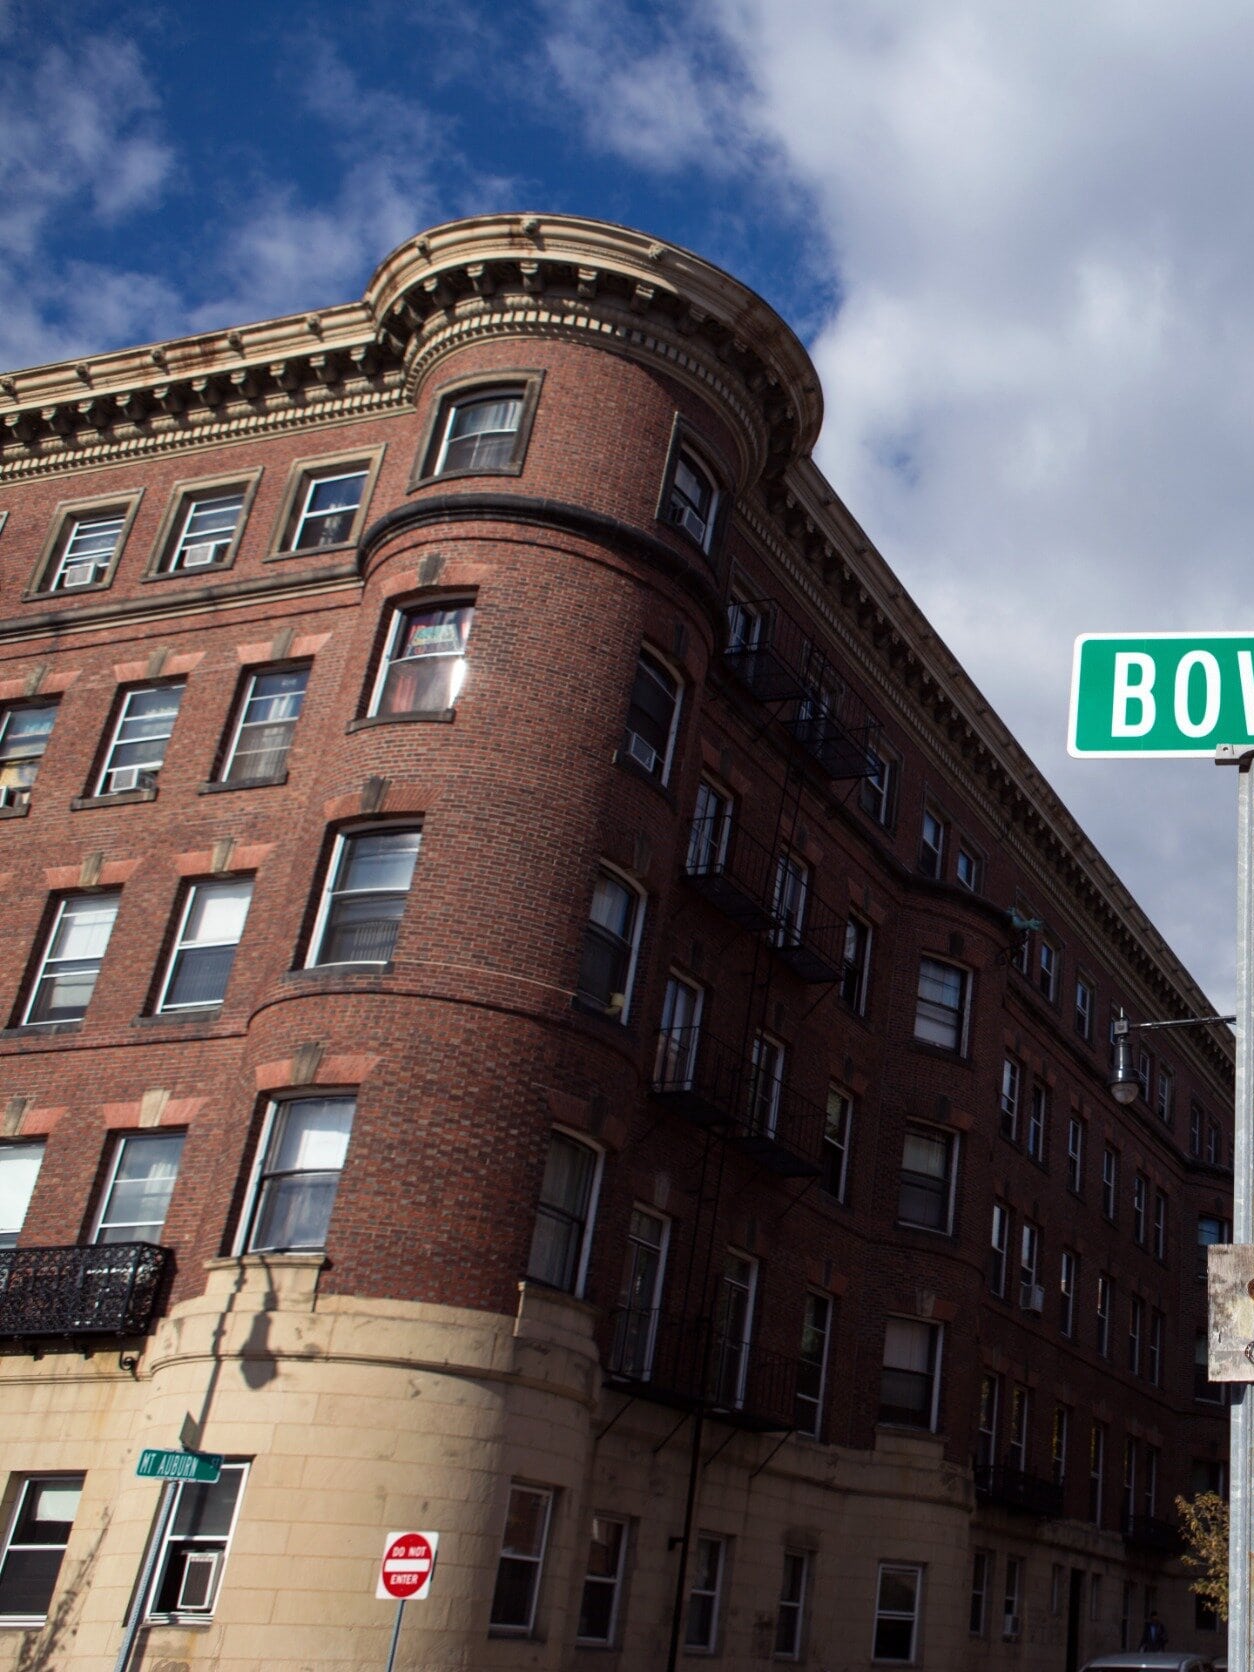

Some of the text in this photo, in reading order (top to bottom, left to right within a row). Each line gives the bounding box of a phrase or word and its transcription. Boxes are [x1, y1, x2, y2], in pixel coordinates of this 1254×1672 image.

[140, 1453, 156, 1474] MT
[157, 1454, 199, 1477] AUBURN
[392, 1546, 427, 1557] DO NOT
[390, 1574, 418, 1585] ENTER
